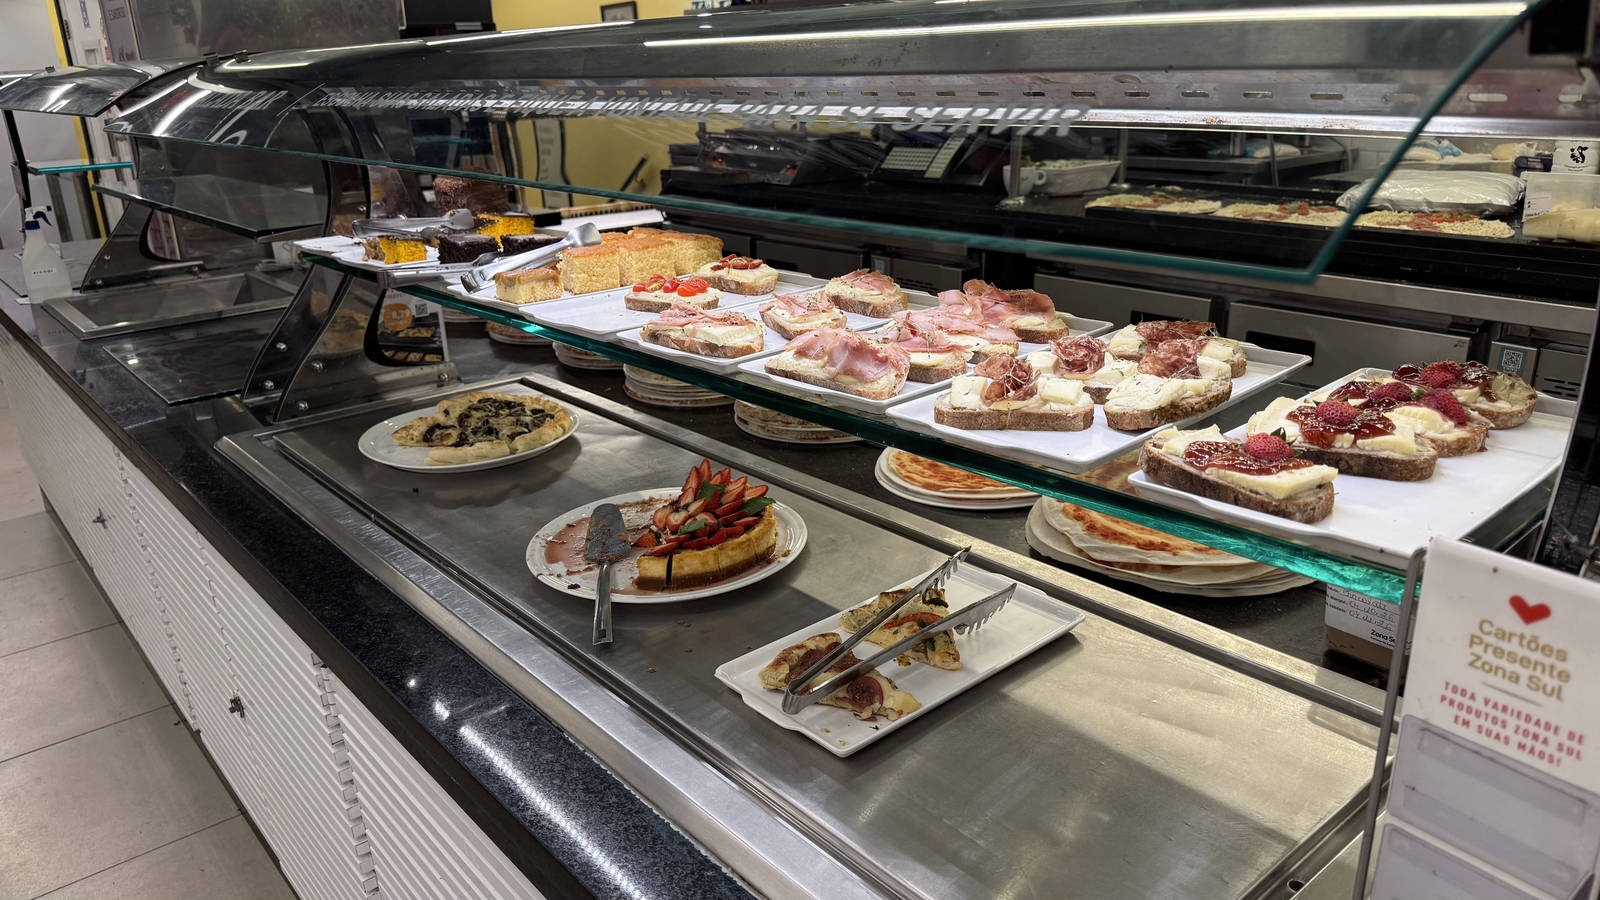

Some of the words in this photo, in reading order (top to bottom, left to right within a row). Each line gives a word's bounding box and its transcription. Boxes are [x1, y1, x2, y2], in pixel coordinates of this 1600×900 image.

[235, 90, 288, 110] BAR
[828, 100, 897, 130] SE
[892, 102, 1090, 137] SERVIR
[1370, 629, 1388, 641] Zona
[1478, 618, 1568, 663] Cartões
[1468, 634, 1571, 683] Presente
[1468, 651, 1521, 685] Zona
[1526, 675, 1564, 702] Sul
[1440, 694, 1508, 729] PRODUTOS
[1514, 724, 1549, 746] ZONA
[1557, 742, 1582, 761] SUL
[1444, 681, 1476, 701] TODA
[1483, 697, 1560, 736] VARIEDADE
[1567, 730, 1585, 746] DE
[1453, 714, 1470, 729] EM
[1476, 724, 1510, 745] SUAS
